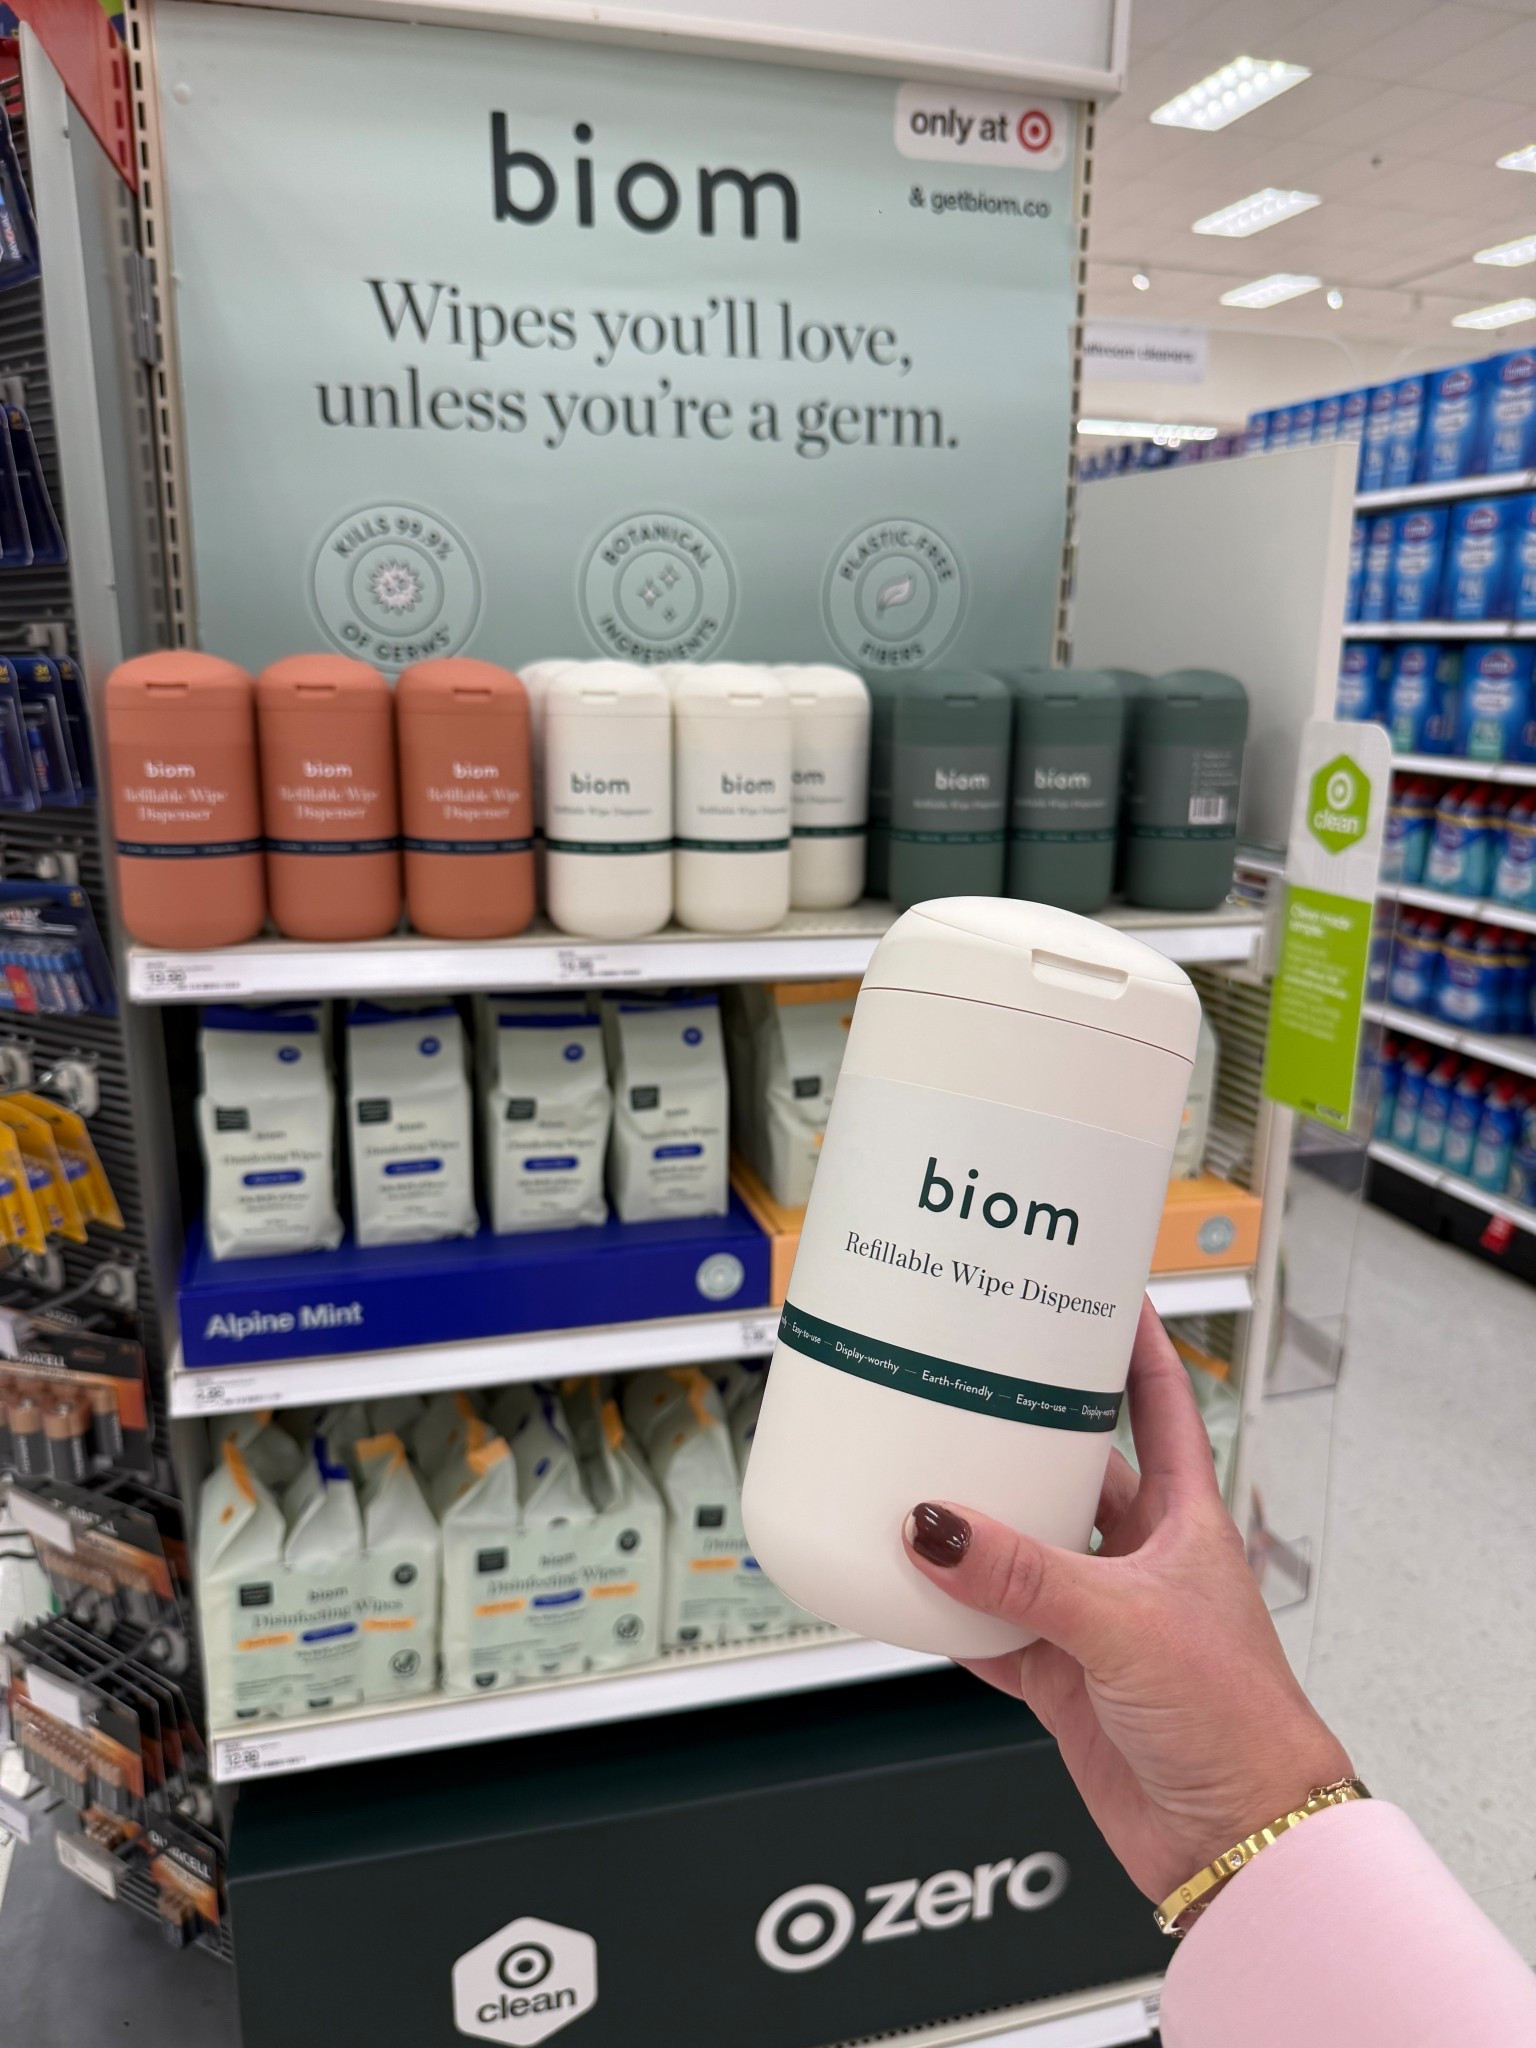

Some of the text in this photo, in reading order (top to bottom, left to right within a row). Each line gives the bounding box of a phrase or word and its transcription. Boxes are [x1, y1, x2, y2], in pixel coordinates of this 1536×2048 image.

[910, 106, 1008, 145] only at
[490, 110, 799, 242] biom
[909, 183, 1052, 219] & getbiom.co
[363, 278, 913, 377] Wipes you’ll love,
[314, 364, 958, 460] unless you’re a germ.
[333, 513, 452, 560] KILLS 99.9%
[601, 523, 711, 568] BOTANICAL
[839, 530, 952, 584] PLASTIC-FREE
[340, 620, 371, 648] OF
[600, 615, 717, 664] INGREDIENTS
[860, 640, 925, 666] FIBERS
[144, 761, 196, 778] biom
[303, 761, 352, 778] biom
[453, 763, 499, 779] biom
[570, 772, 630, 794] biom
[721, 772, 776, 794] biom
[791, 768, 825, 785] om
[935, 767, 989, 790] biom
[1034, 766, 1091, 789] biom
[1313, 809, 1360, 835] clean
[918, 1157, 1078, 1246] biom
[845, 1231, 1116, 1318] Refillable Wipe Dispenser
[205, 1301, 365, 1341] Alpine Mint
[792, 1321, 821, 1344] Easy-to-use
[835, 1341, 900, 1374] Display-worthy
[922, 1369, 993, 1400] Earth-friendly
[1015, 1393, 1066, 1412] Easy-to-use
[861, 1851, 1071, 1944] zero
[476, 1986, 577, 2022] clean
